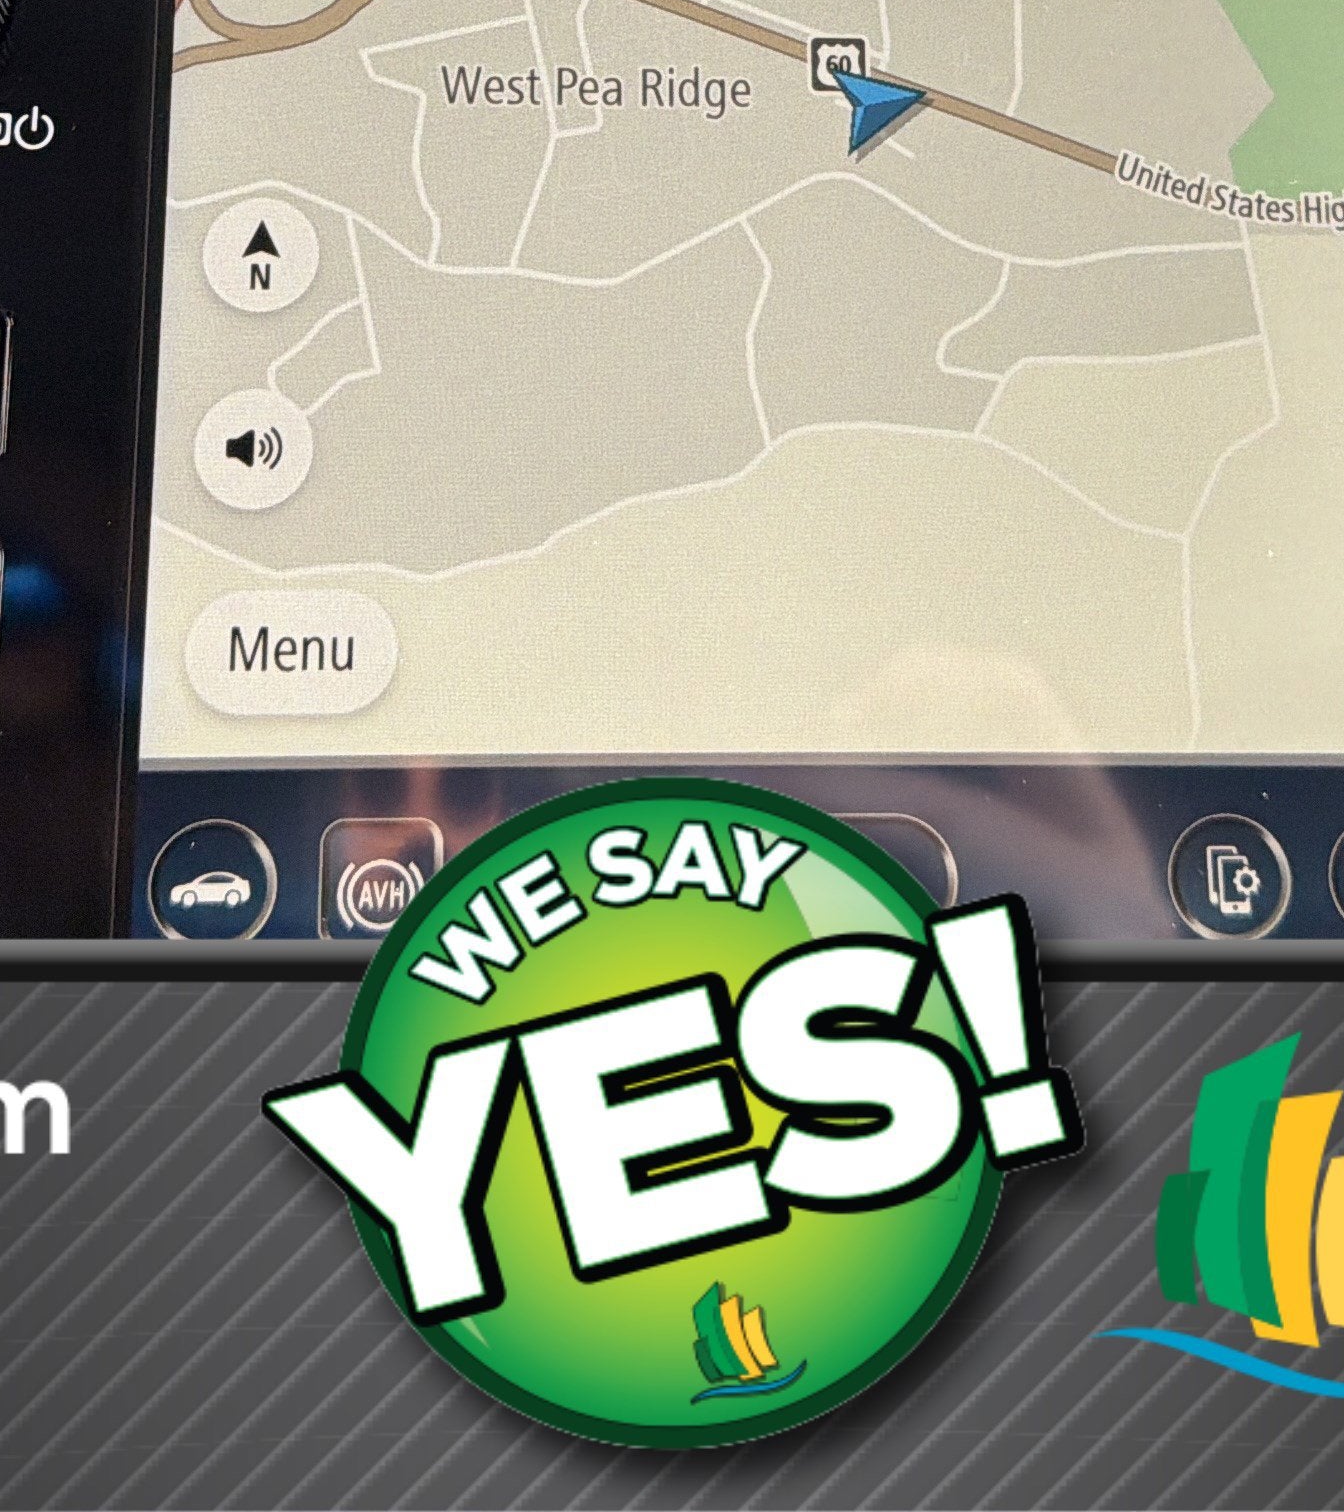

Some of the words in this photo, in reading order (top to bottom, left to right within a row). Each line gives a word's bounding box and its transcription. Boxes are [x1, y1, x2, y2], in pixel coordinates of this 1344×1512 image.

[441, 65, 540, 105] West
[557, 67, 622, 106] Pea
[642, 66, 751, 119] Ridge
[1119, 152, 1205, 205] United
[1211, 184, 1295, 223] States
[250, 263, 271, 290] N
[229, 626, 354, 672] Menu
[358, 880, 405, 911] AVH
